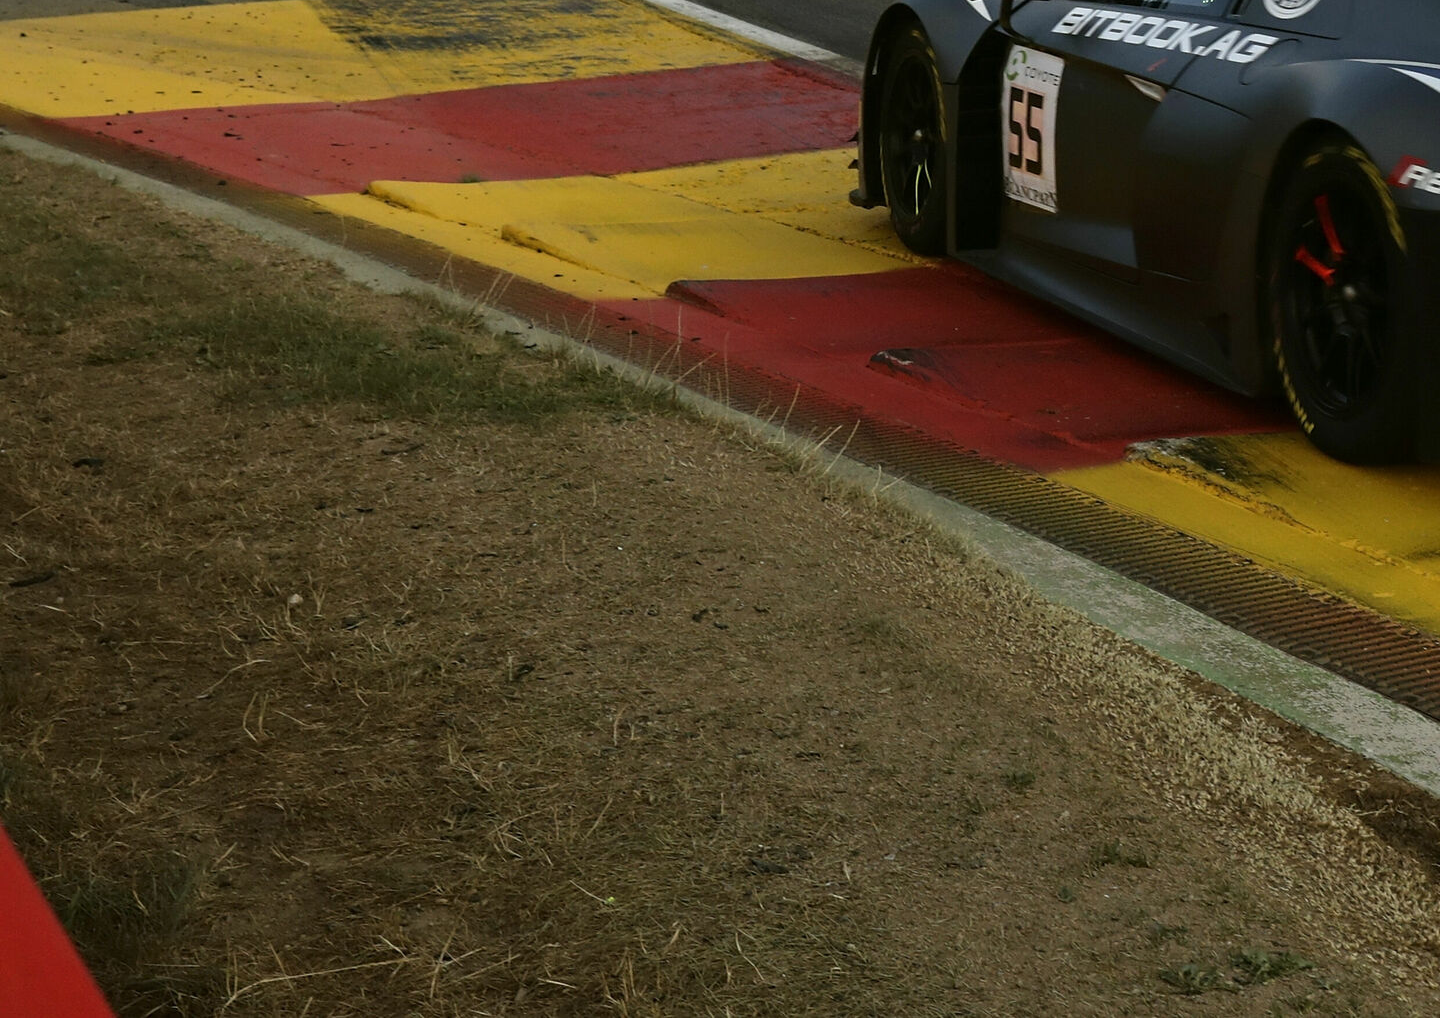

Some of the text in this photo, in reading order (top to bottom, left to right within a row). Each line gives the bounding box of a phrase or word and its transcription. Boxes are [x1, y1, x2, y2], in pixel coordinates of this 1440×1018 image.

[1052, 7, 1280, 63] BITBOOK.AG
[1024, 66, 1060, 86] COYOTE
[1009, 86, 1044, 176] 55
